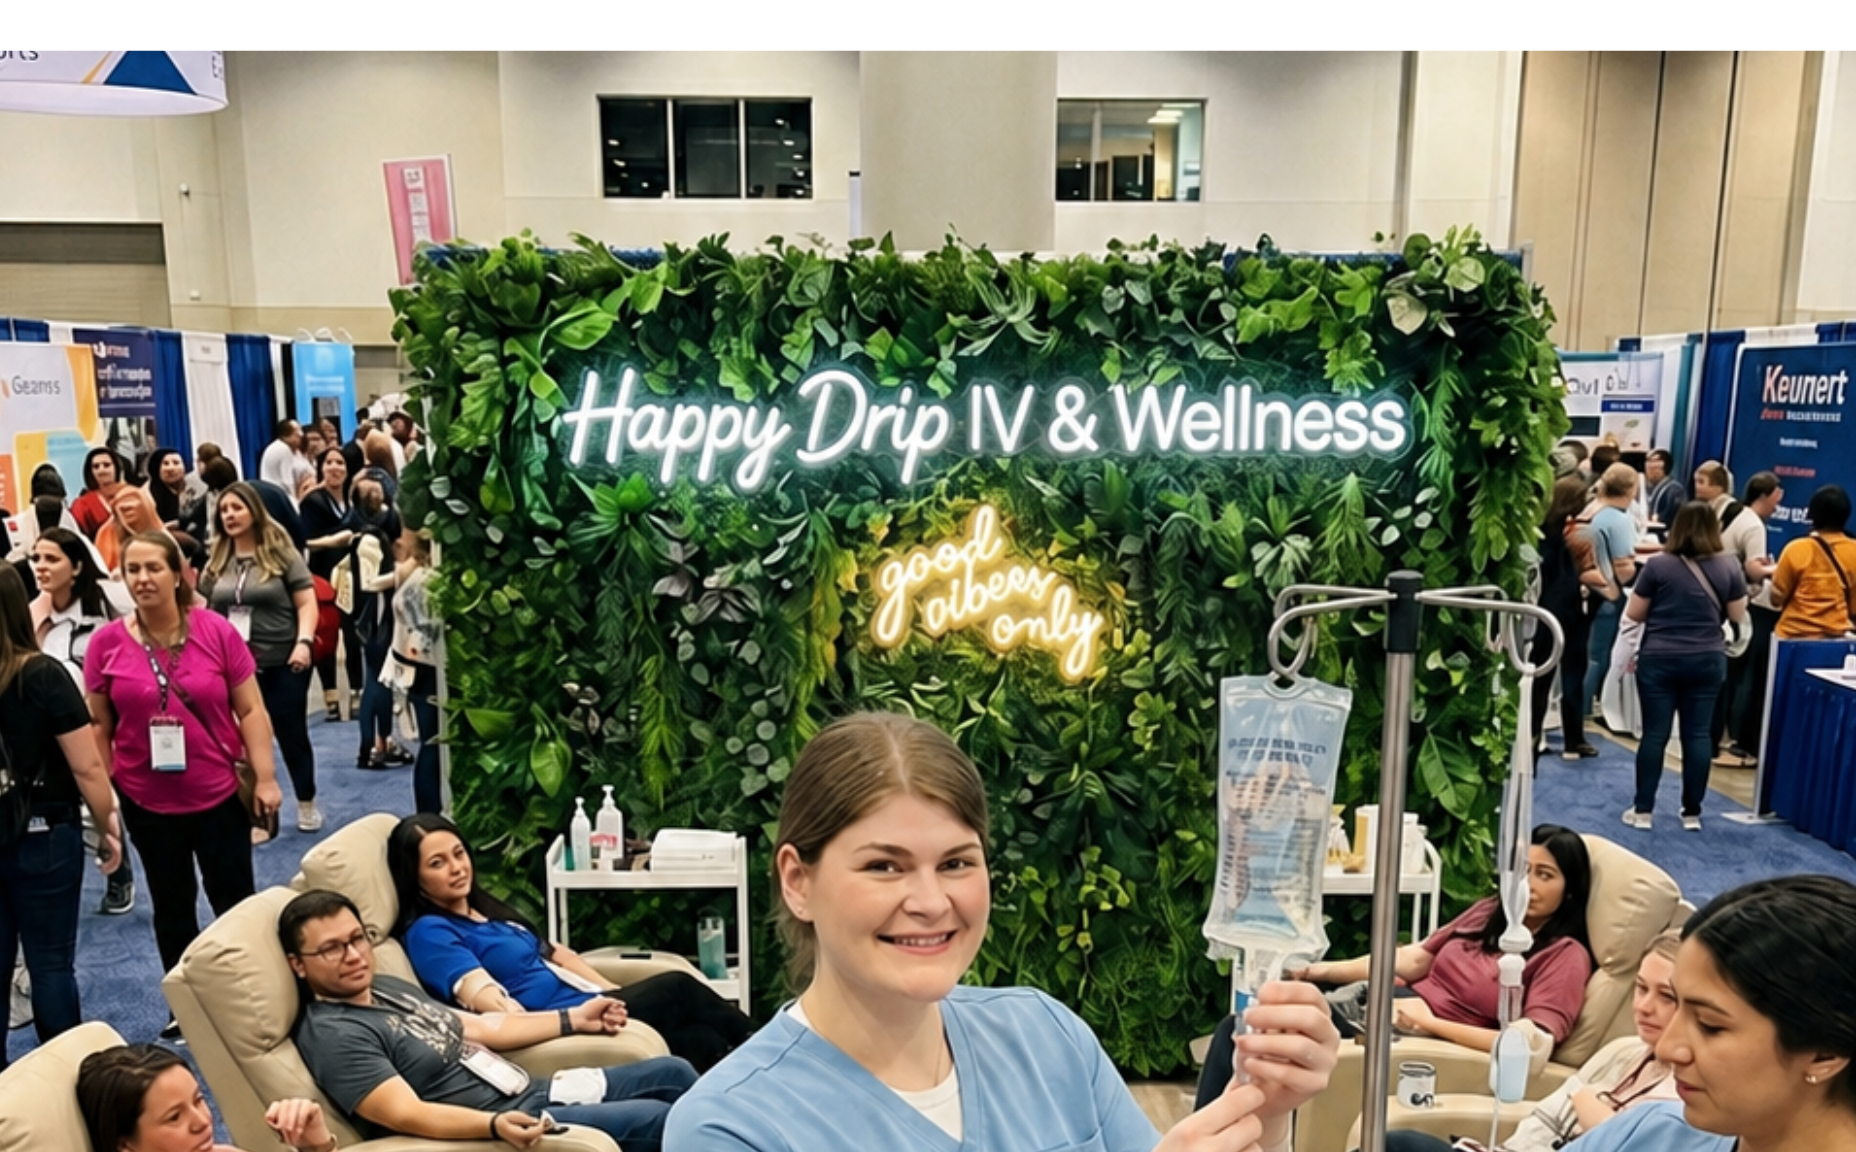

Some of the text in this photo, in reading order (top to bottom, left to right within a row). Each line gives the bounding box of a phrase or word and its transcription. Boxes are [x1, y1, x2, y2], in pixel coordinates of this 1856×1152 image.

[562, 369, 1406, 490] Happy Drip IV & Wellness
[1762, 363, 1848, 405] Keunert
[876, 504, 1003, 643] good
[991, 584, 1104, 676] only
